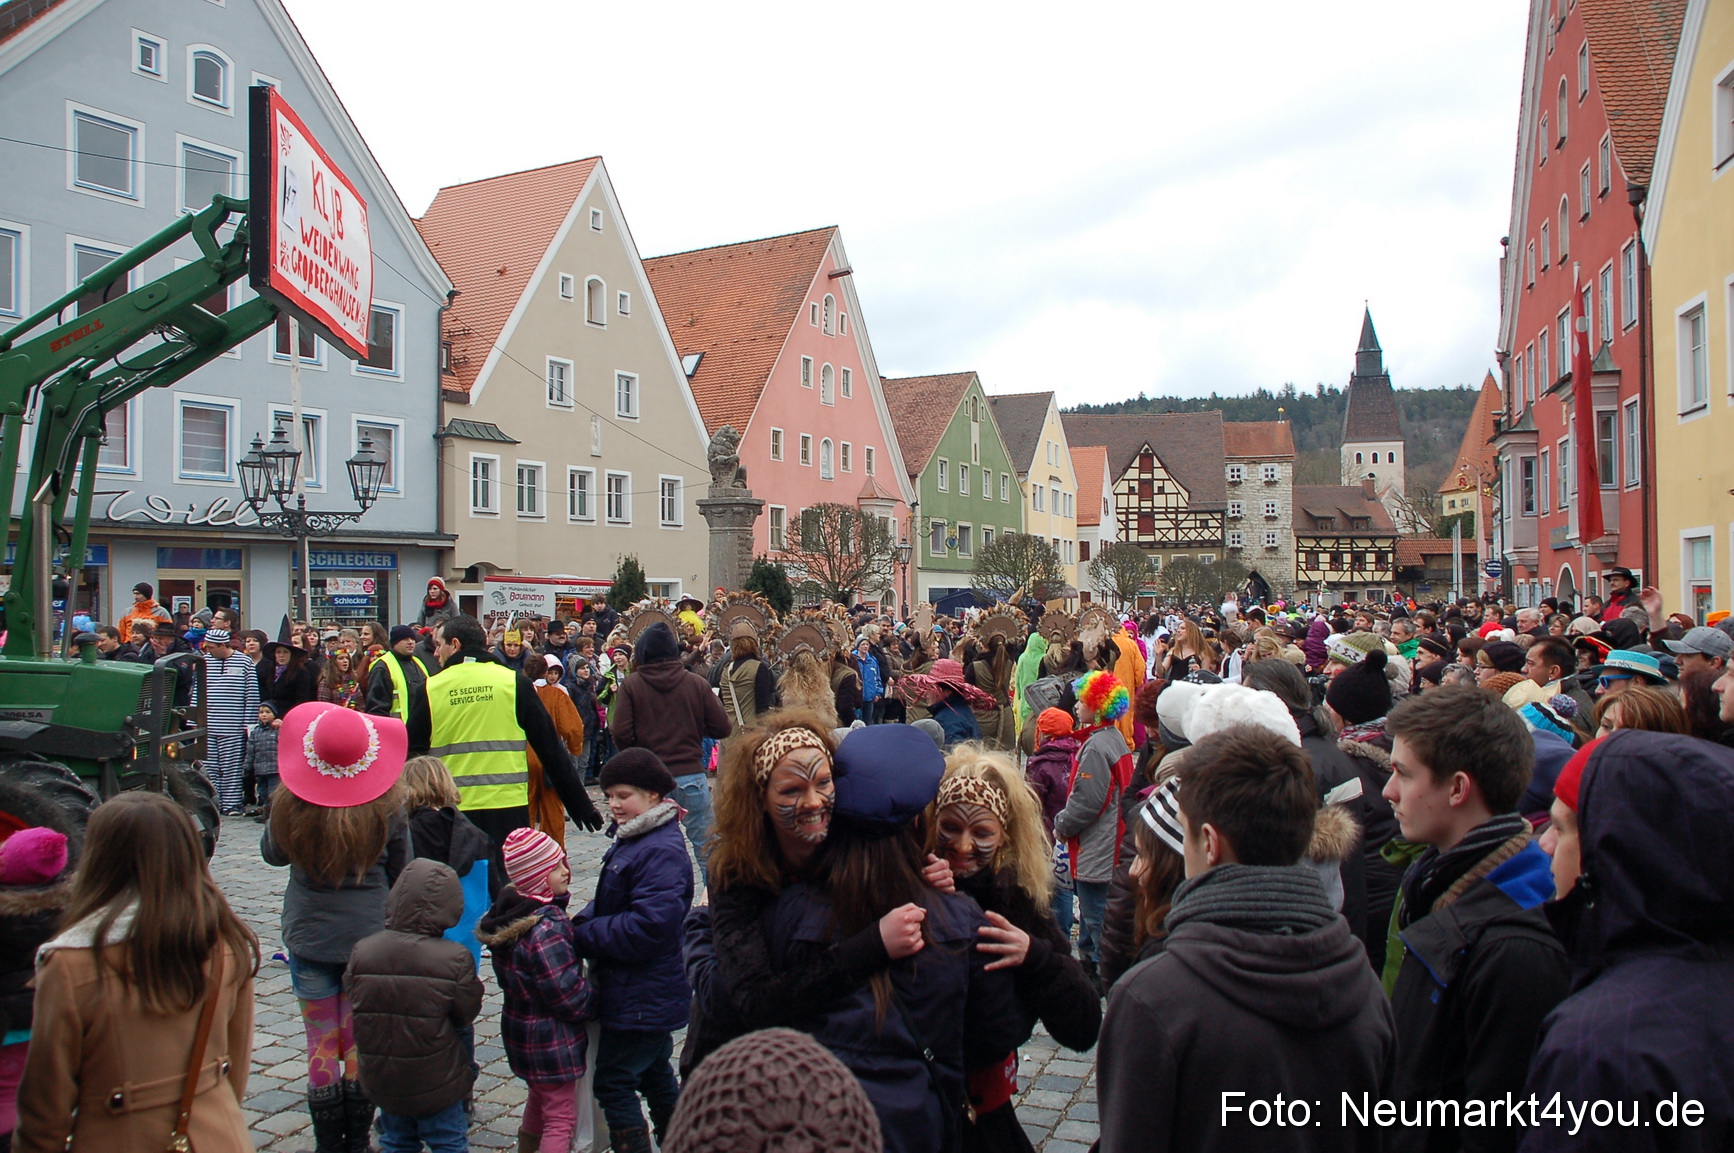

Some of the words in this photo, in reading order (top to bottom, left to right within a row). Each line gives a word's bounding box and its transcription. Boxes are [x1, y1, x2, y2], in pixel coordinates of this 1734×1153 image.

[299, 215, 359, 291] WEIDENWANG
[49, 319, 105, 353] STOLL
[308, 553, 392, 567] SCHLECKER
[334, 597, 368, 605] Schlecker
[490, 609, 536, 618] Brot-obil
[449, 689, 459, 697] CS
[459, 685, 494, 695] SECURITY
[450, 695, 475, 705] SERVICE
[475, 694, 494, 702] GmbH
